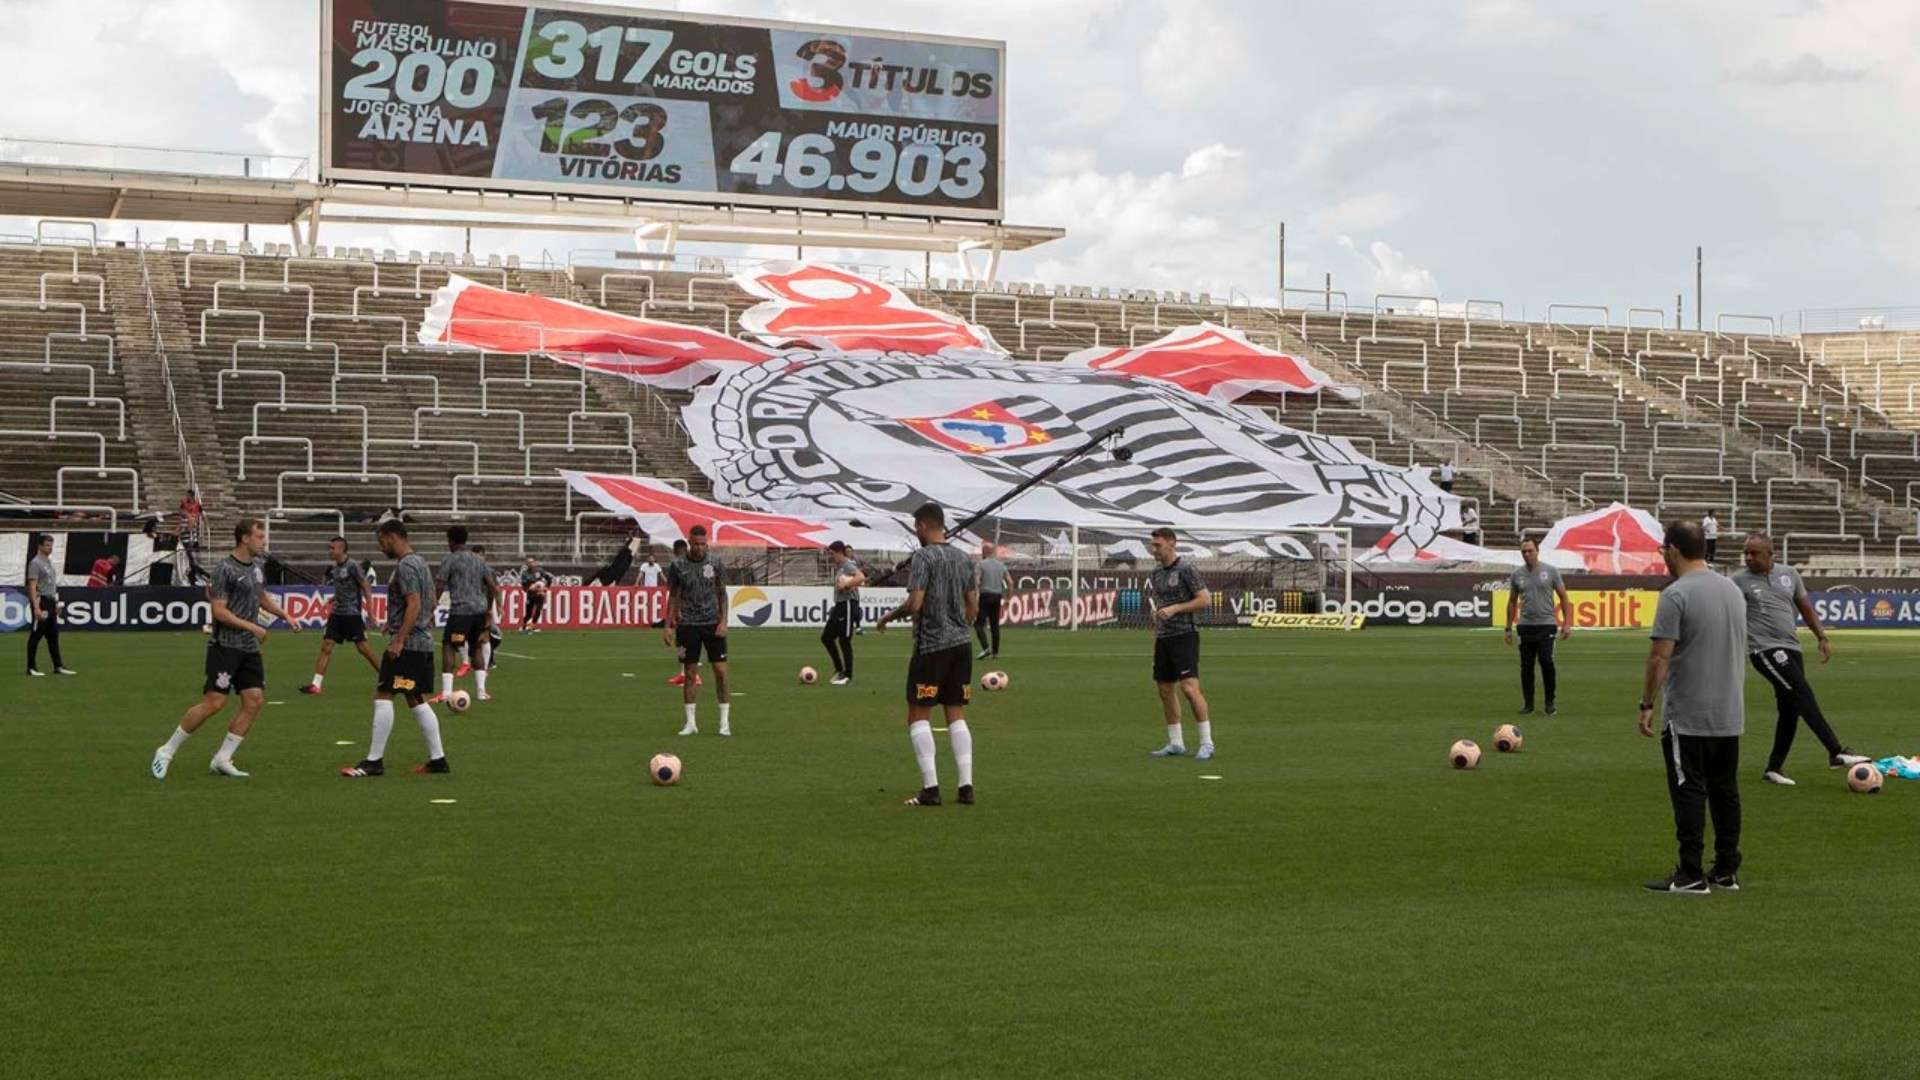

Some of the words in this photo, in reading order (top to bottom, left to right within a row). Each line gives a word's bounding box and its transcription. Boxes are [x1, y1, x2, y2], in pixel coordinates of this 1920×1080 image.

[352, 20, 430, 38] FUTEBOL
[356, 32, 496, 58] MASCULINO
[532, 19, 674, 84] 317
[343, 48, 495, 109] 200
[669, 49, 757, 80] GOLS
[790, 40, 848, 103] 3
[848, 57, 993, 98] TÍTULOS
[653, 74, 755, 95] MARCADOS
[343, 100, 411, 116] JOGOS
[415, 104, 442, 119] NA
[358, 112, 488, 146] ARENA
[531, 97, 668, 161] 123
[826, 120, 896, 142] MAIOR
[898, 123, 987, 149] PÚBLICO
[558, 156, 681, 184] VITÓRIAS
[730, 131, 988, 199] 46.903
[492, 589, 571, 625] VEHO
[579, 590, 670, 625] BARRE
[1257, 614, 1361, 627] quartzolt
[1321, 592, 1490, 624] bodog.net
[1798, 599, 1867, 621] SSAÍ
